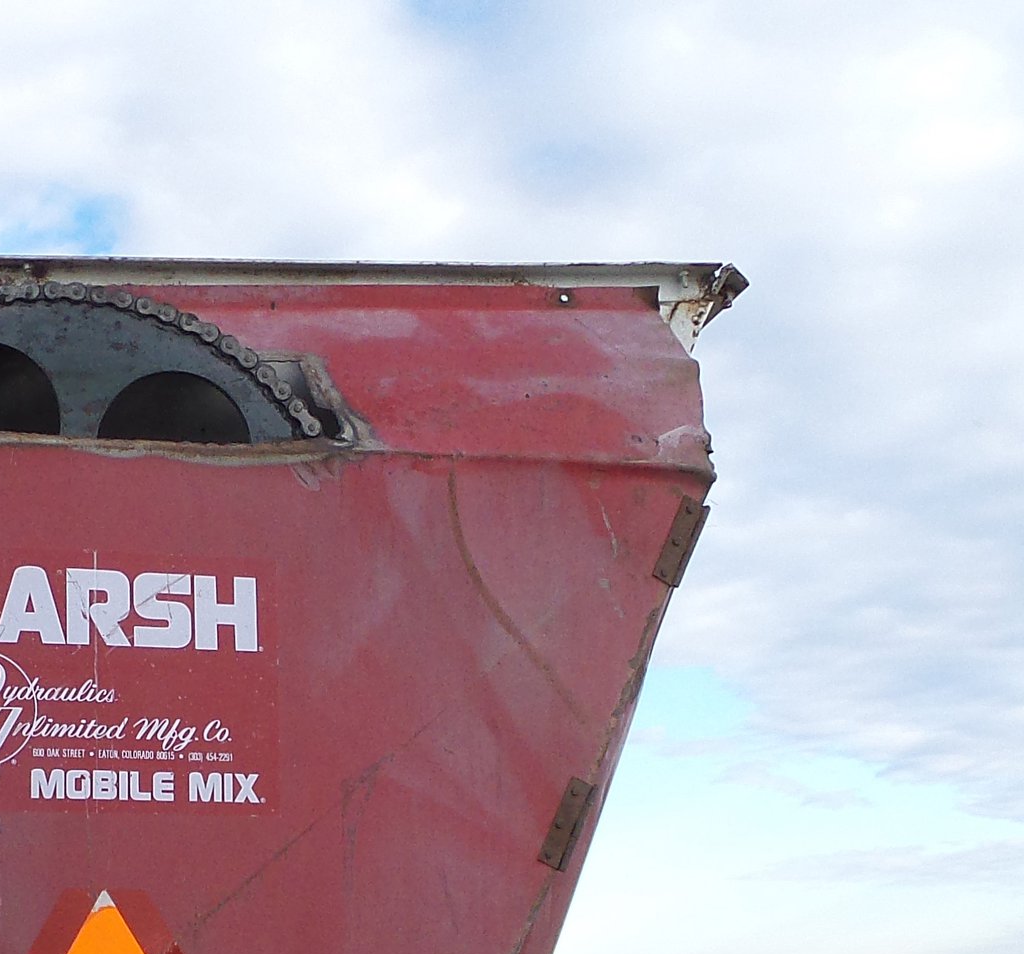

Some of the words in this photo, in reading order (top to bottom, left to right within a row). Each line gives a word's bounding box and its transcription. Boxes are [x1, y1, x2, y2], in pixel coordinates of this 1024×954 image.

[133, 717, 199, 751] Mfg.
[204, 719, 233, 743] Co.
[46, 748, 60, 757] OAK
[62, 749, 86, 758] STREET
[98, 749, 120, 760] EATON,
[121, 750, 154, 760] COLORADO
[30, 768, 174, 801] MOBILE
[189, 771, 261, 803] MIX
